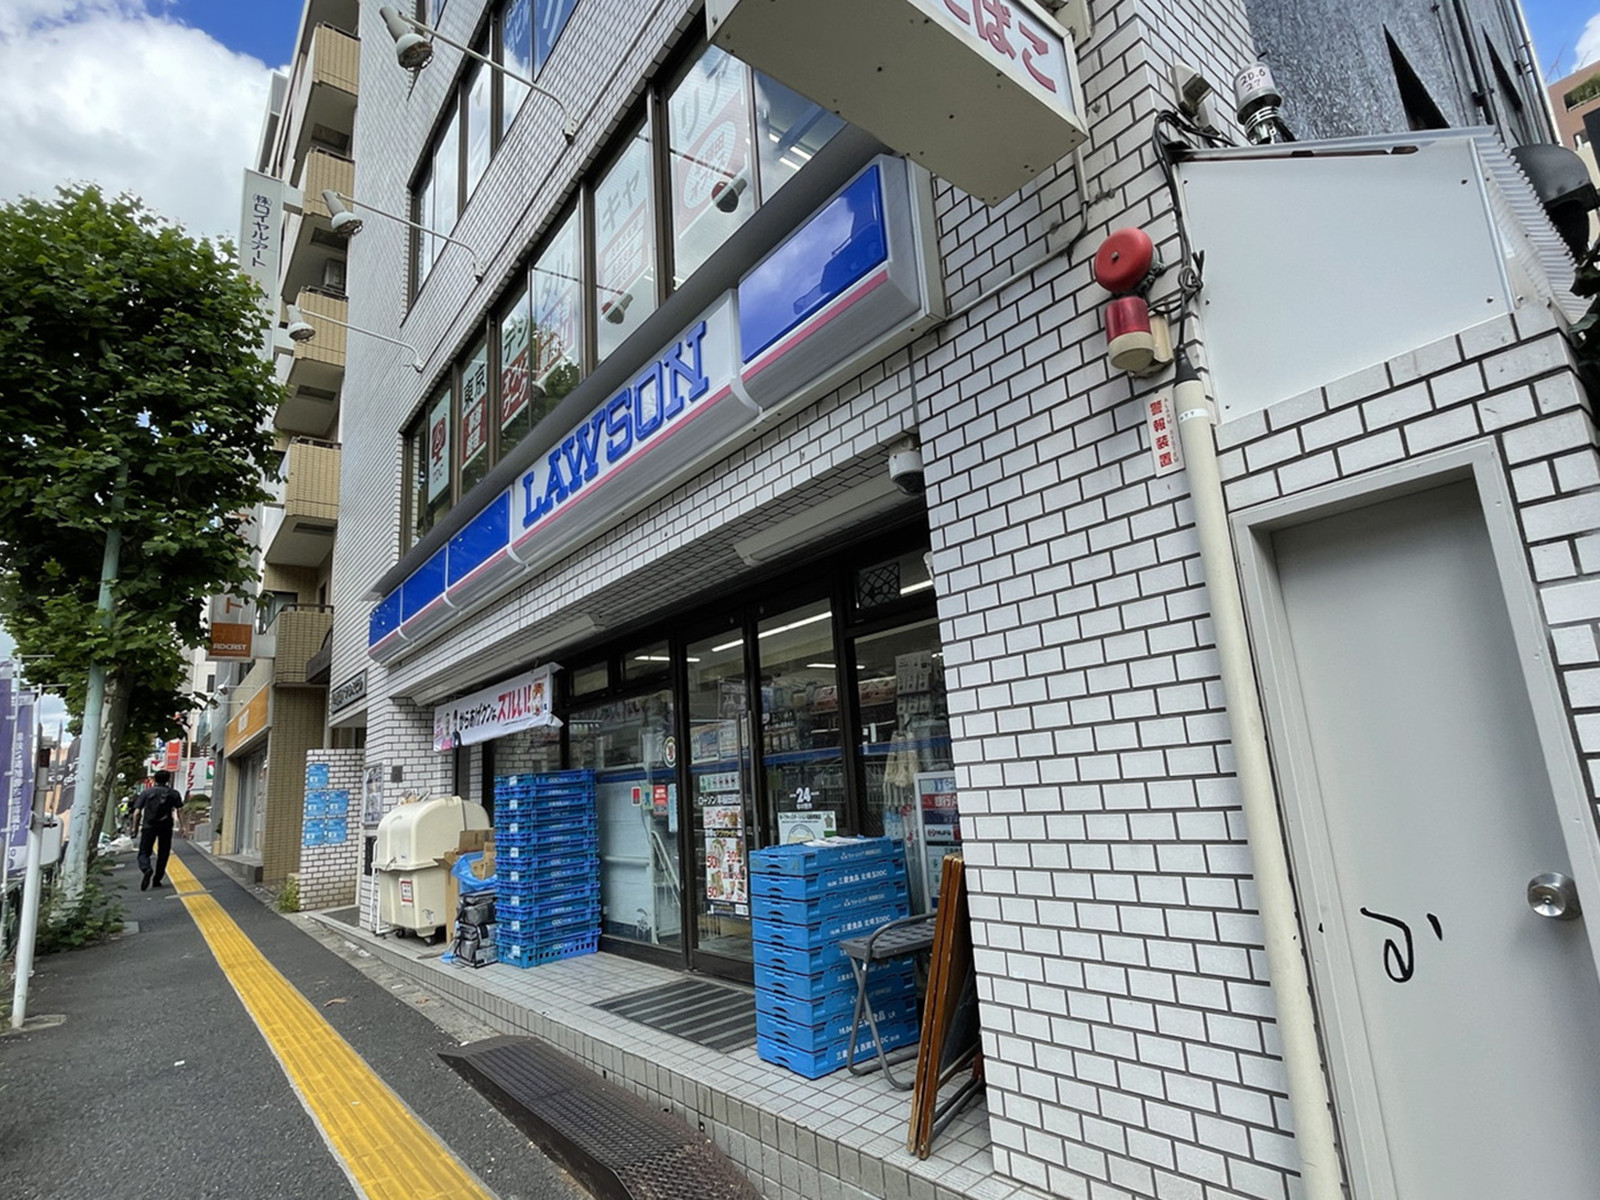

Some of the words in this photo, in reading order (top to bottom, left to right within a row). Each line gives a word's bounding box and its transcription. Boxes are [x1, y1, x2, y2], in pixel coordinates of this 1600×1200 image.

[944, 0, 1057, 93] ばこ
[463, 364, 486, 413] 東京
[602, 170, 640, 231] キャ
[523, 321, 709, 528] LAWSON
[1149, 400, 1173, 468] 警報装置
[795, 787, 812, 803] 24
